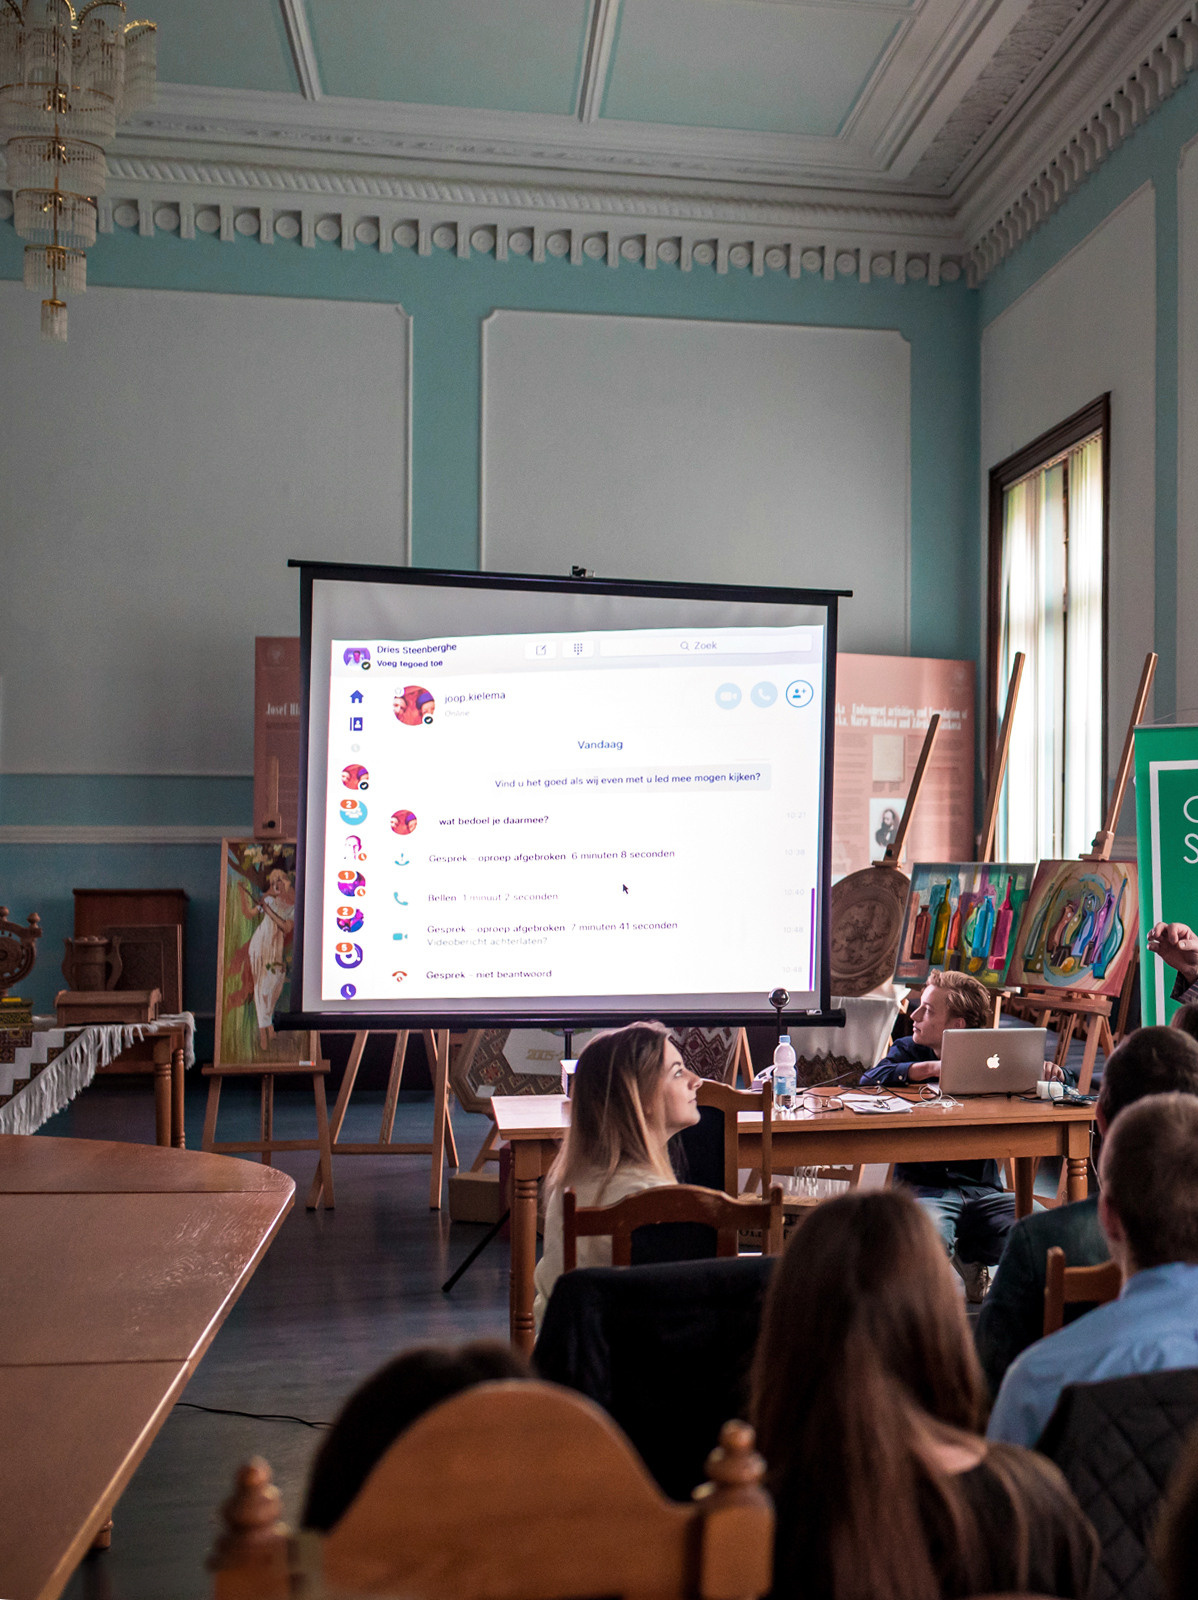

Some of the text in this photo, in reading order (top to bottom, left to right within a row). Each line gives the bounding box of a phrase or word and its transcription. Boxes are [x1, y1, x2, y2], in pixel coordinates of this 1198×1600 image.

[376, 643, 457, 655] Dries Steenberghe
[694, 641, 717, 650] Zoek
[377, 660, 397, 668] Voeg
[400, 660, 428, 668] tegoed
[578, 740, 624, 750] Vandaag
[495, 780, 515, 788] Vind
[526, 779, 541, 787] het
[544, 778, 568, 788] goed
[570, 777, 584, 785] als
[586, 776, 599, 786] wij
[601, 776, 623, 784] even
[626, 775, 644, 783] met
[655, 775, 669, 783] led
[694, 775, 726, 783] mogen
[729, 772, 761, 782] kijken?
[458, 817, 490, 825] bedoel
[492, 817, 500, 826] je
[503, 816, 549, 824] daarmee?
[428, 854, 468, 863] Gesprek
[478, 855, 511, 863] oproep
[513, 853, 566, 863] afgebroken
[571, 852, 578, 860] 6
[580, 852, 618, 860] minuten
[620, 850, 627, 858] 8
[630, 850, 675, 858] seconden
[513, 893, 558, 901] seconden
[427, 925, 466, 933] Gesprek
[477, 926, 511, 934] oproep
[513, 924, 565, 933] afgebroken
[632, 922, 678, 930] seconden
[426, 970, 466, 980] Gesprek
[497, 970, 552, 978] beantwoord
